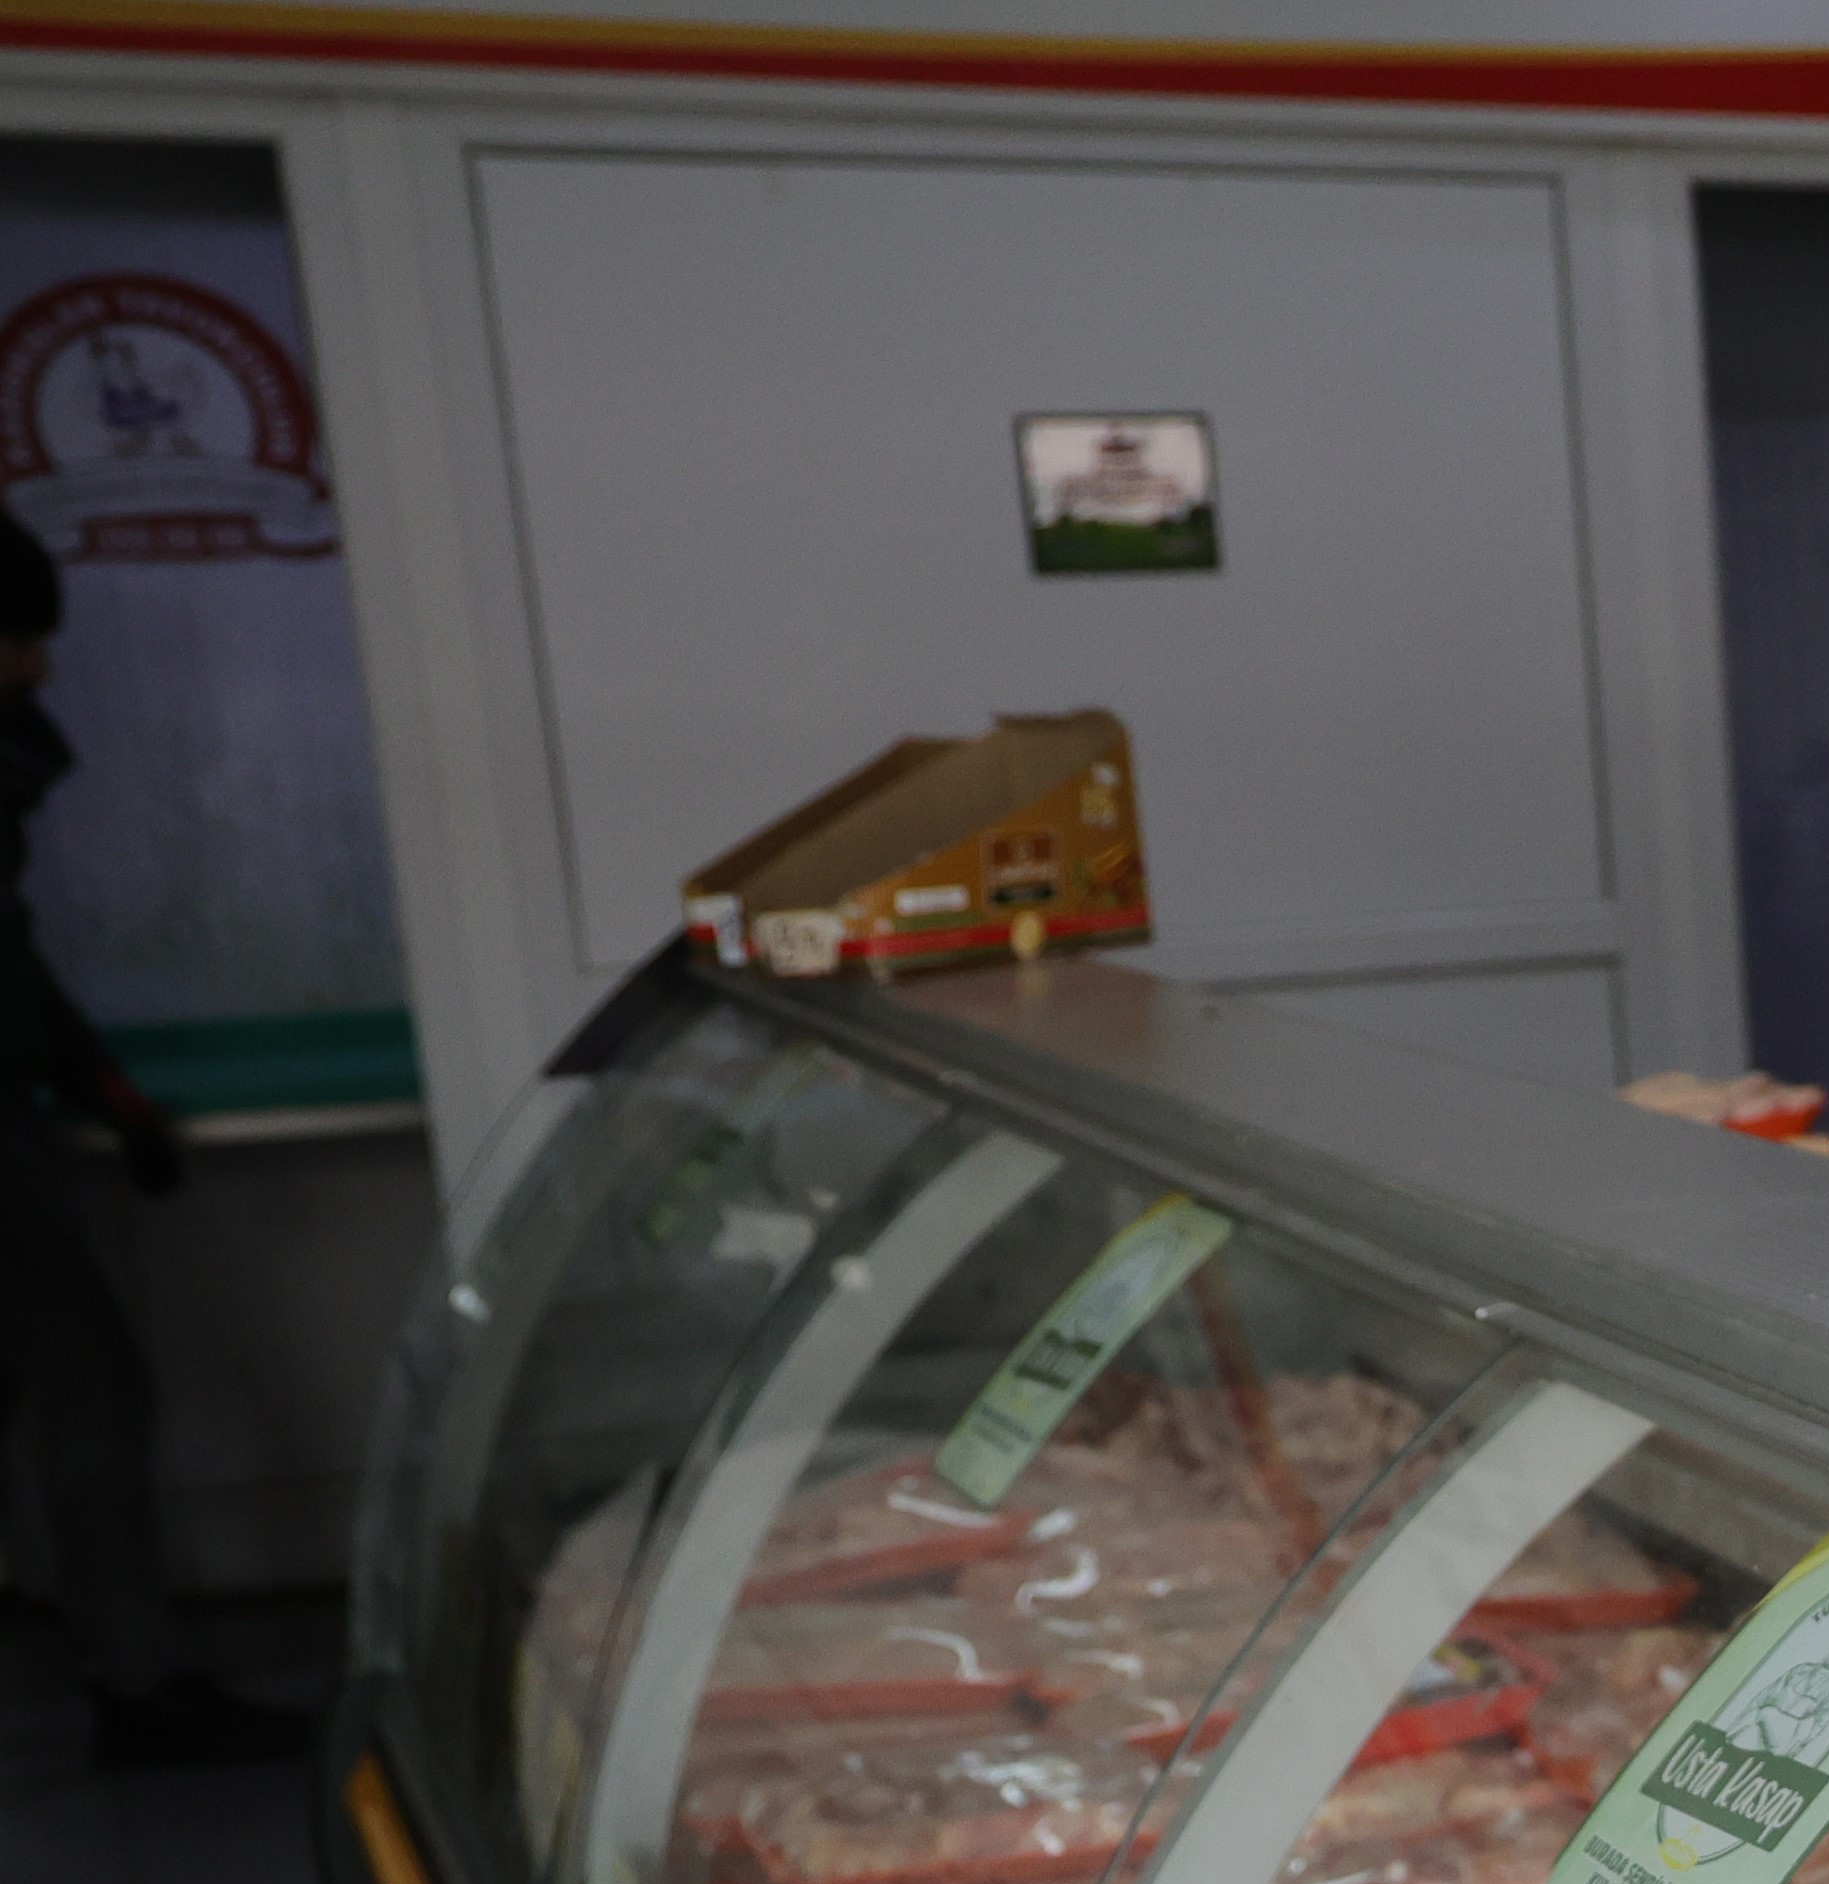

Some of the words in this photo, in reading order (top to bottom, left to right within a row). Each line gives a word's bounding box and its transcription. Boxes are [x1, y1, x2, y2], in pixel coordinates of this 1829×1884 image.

[1661, 1734, 1729, 1799] Usta
[1713, 1757, 1804, 1844] Kasap
[1583, 1833, 1630, 1876] BURADA
